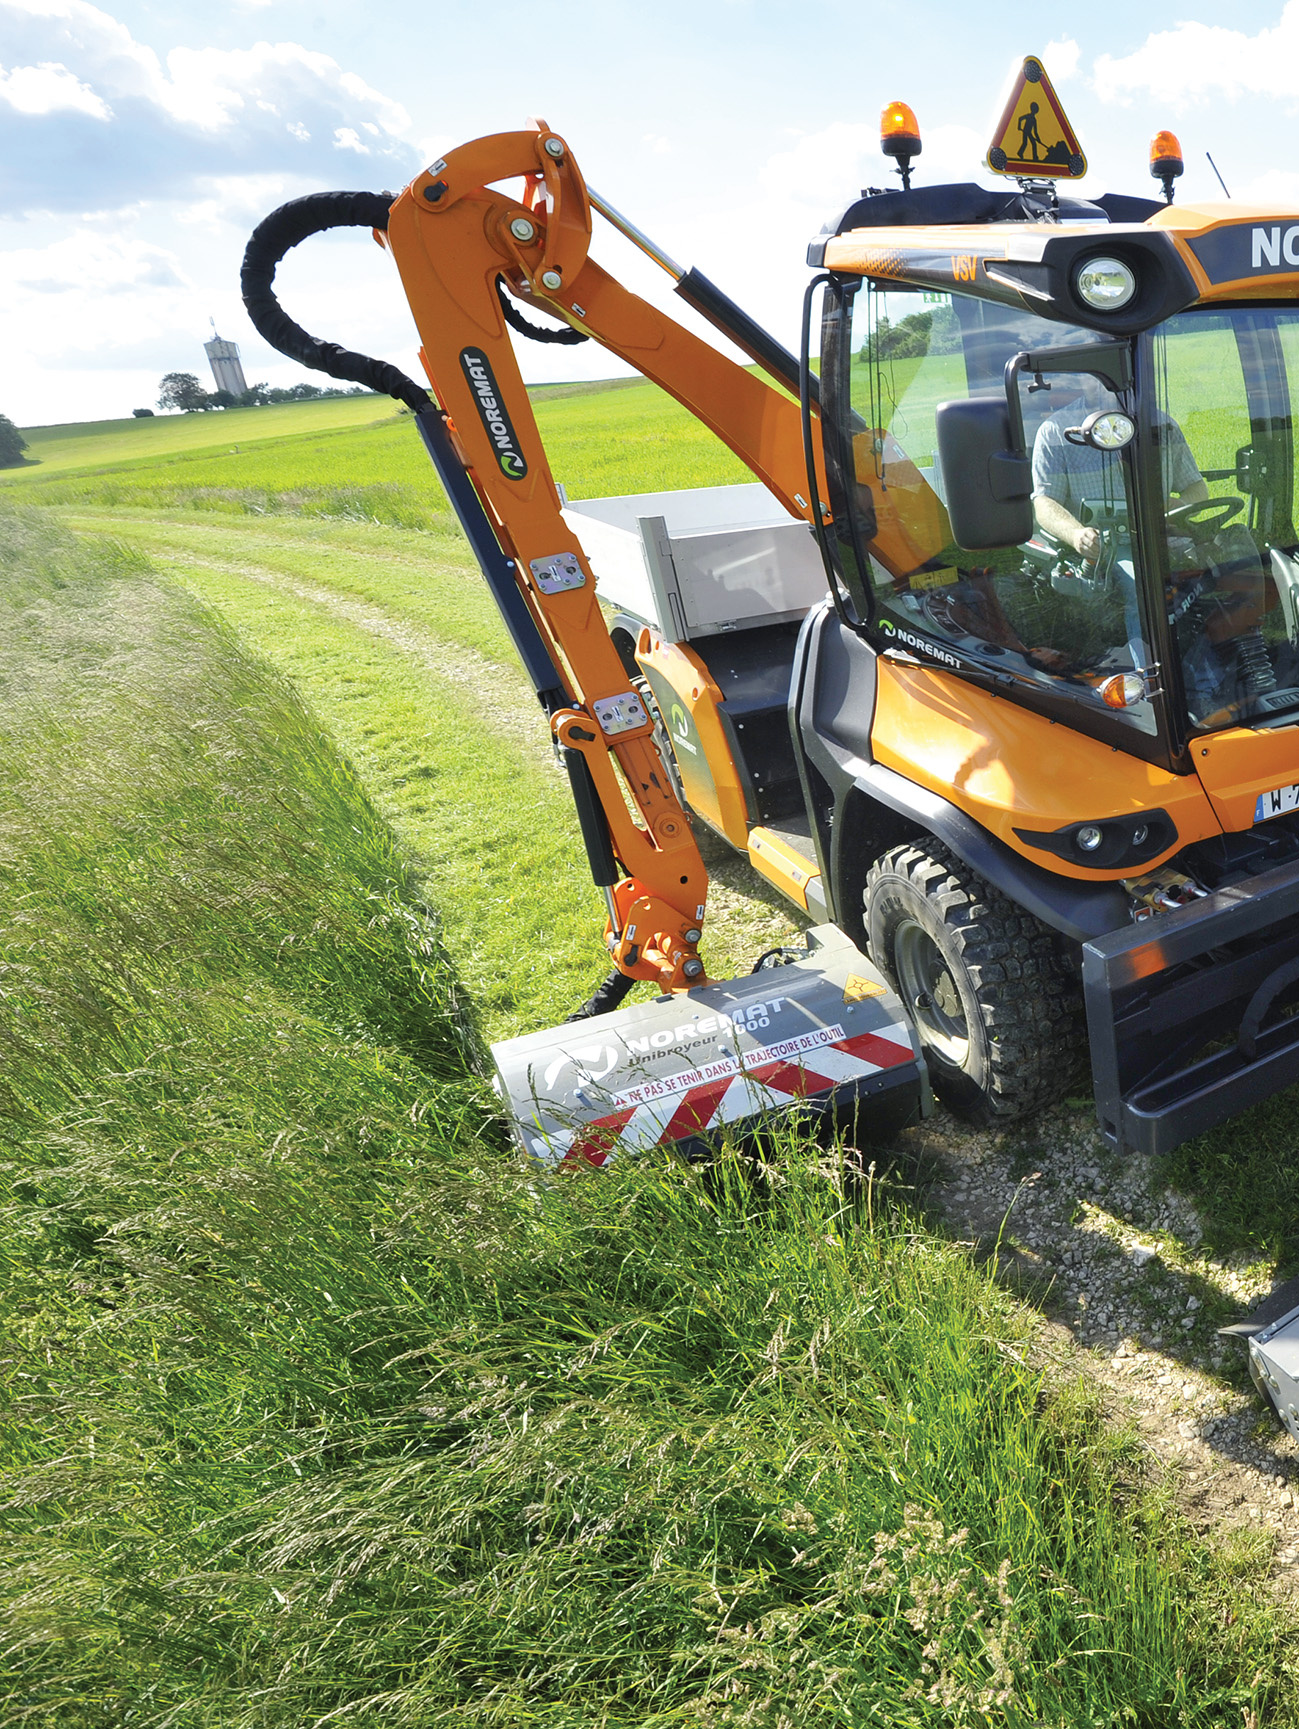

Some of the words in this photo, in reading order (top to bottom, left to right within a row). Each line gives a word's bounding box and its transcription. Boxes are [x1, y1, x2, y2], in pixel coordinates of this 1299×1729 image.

[951, 255, 977, 281] VSV
[464, 354, 513, 449] NOREMAT
[897, 629, 963, 669] NOREMAT
[626, 997, 785, 1057] NOREMAT
[629, 1035, 718, 1067] Unibroyeur
[722, 1016, 770, 1038] 1000
[629, 1090, 643, 1103] NE
[643, 1084, 664, 1099] PAS
[665, 1079, 676, 1091] SE
[676, 1070, 704, 1088] TENIR
[706, 1062, 733, 1078] DANS
[745, 1040, 800, 1065] TRAJECTOIRE
[800, 1038, 812, 1049] DE
[814, 1029, 844, 1046] L'OUTIL
